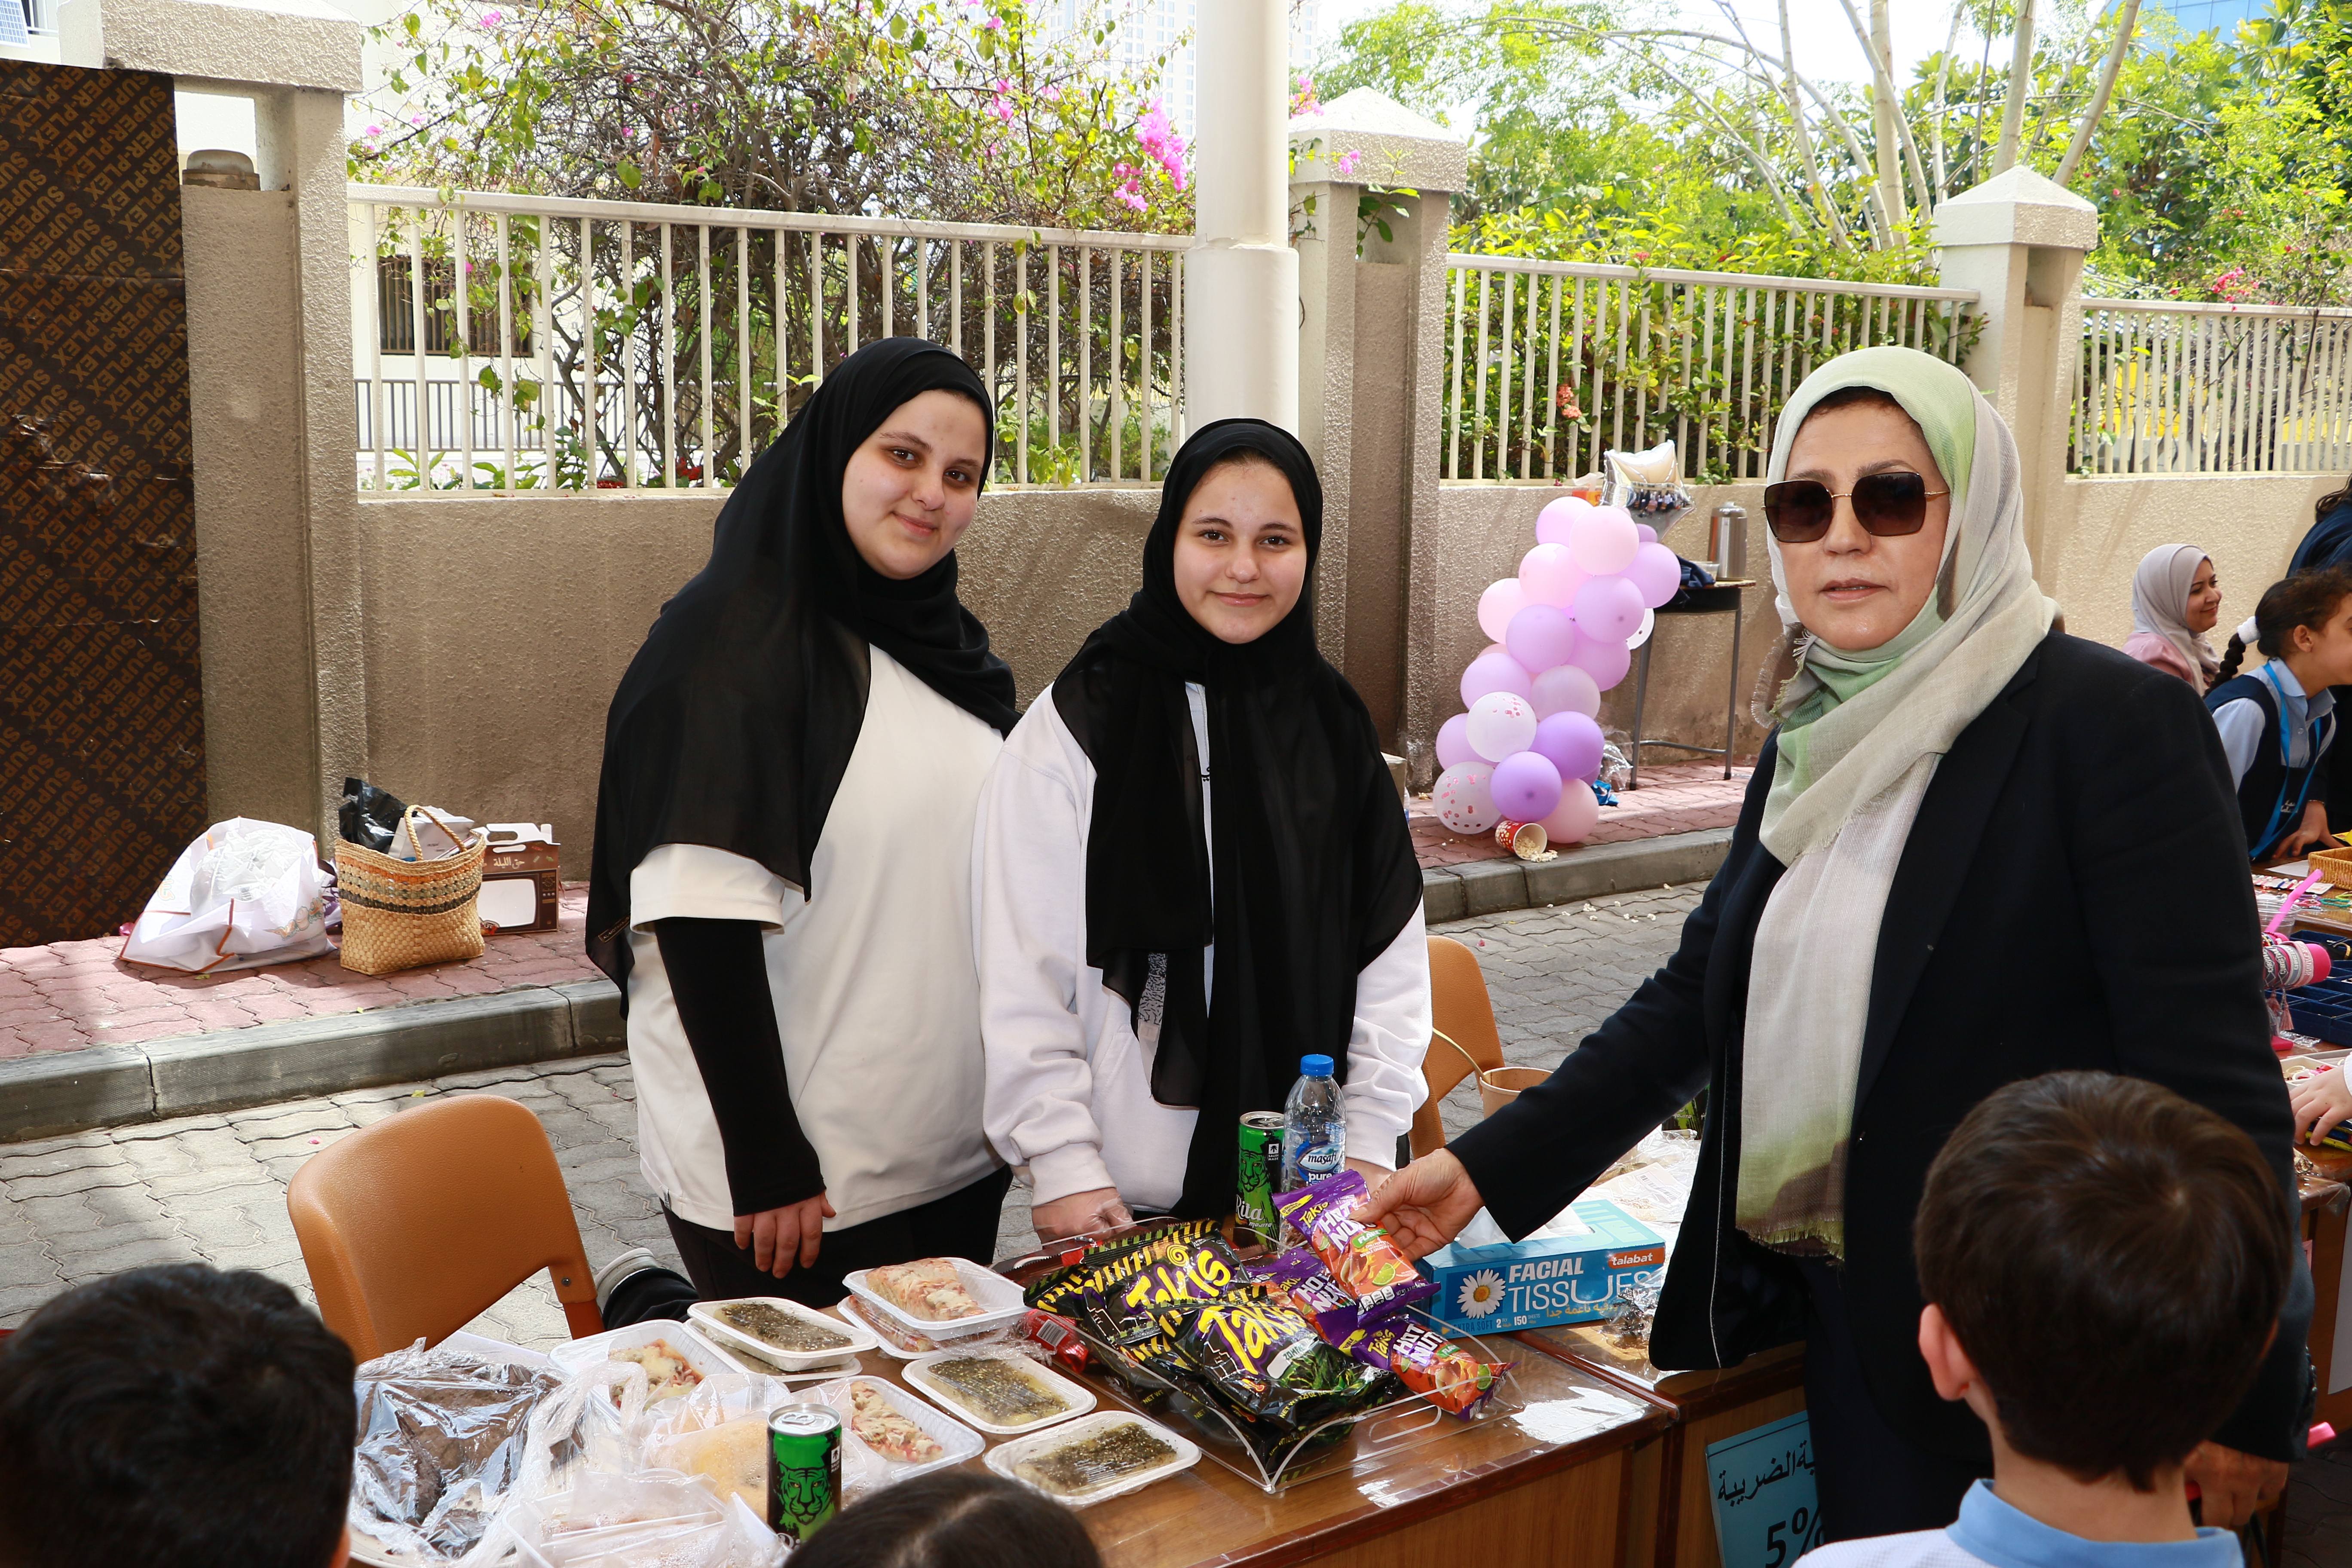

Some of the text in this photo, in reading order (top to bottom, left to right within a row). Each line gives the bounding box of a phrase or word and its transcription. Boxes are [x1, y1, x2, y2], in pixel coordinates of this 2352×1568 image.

[12, 64, 91, 133] ER-PLEX
[48, 70, 150, 168] SUPER-PLEX
[66, 86, 167, 186] SUPER-PLEX
[101, 129, 179, 217] PER-PLEX
[0, 202, 83, 298] SUPER-PLE
[0, 217, 101, 321] SUPER-PLEX
[15, 234, 118, 336] SUPER-PLEX
[34, 250, 135, 352] SUPER-PLEX
[52, 266, 152, 368] SUPER-PLEX
[69, 282, 169, 383] SUPER-PLEX
[87, 297, 186, 398] SUPER-PLEX
[104, 320, 188, 414] UPER-PLEX
[121, 349, 190, 429] ER-PLEX
[138, 380, 191, 444] R-PLEX
[0, 399, 86, 498] SUPER-PLE
[54, 459, 152, 561] SUPER-PLEX
[71, 474, 169, 576] SUPER-PLEX
[89, 487, 186, 590] SUPER-PLEX
[122, 526, 197, 618] PER-PLEX
[4, 606, 105, 711] SUPER-PLEX
[21, 619, 121, 724] SUPER-PLEX
[39, 632, 138, 738] SUPER-PLEX
[55, 646, 154, 751] SUPER-PLEX
[71, 659, 170, 764] SUPER-PLEX
[89, 673, 186, 777] SUPER-PLEX
[104, 686, 202, 790] SUPER-PLEX
[122, 701, 205, 803] UPER-PLEX
[154, 760, 207, 828] R-PLEX
[6, 792, 106, 899] SUPER-PLEX
[23, 804, 122, 912] SUPER-PLEX
[40, 817, 138, 924] SUPER-PLEX
[57, 830, 154, 936] SUPER-PLEX
[1236, 1194, 1264, 1221] Rita
[1308, 1151, 1338, 1168] masafi
[1308, 1172, 1333, 1183] pure
[1508, 1257, 1584, 1283] FACIAL
[1612, 1253, 1653, 1266] talabat
[1367, 1328, 1395, 1359] Takis
[1393, 1323, 1425, 1355] HOT
[1477, 1319, 1494, 1331] SOFT
[1496, 1318, 1502, 1329] 2
[1514, 1315, 1527, 1326] 150
[1142, 1390, 1164, 1404] NET WT
[1279, 1407, 1291, 1418] NET
